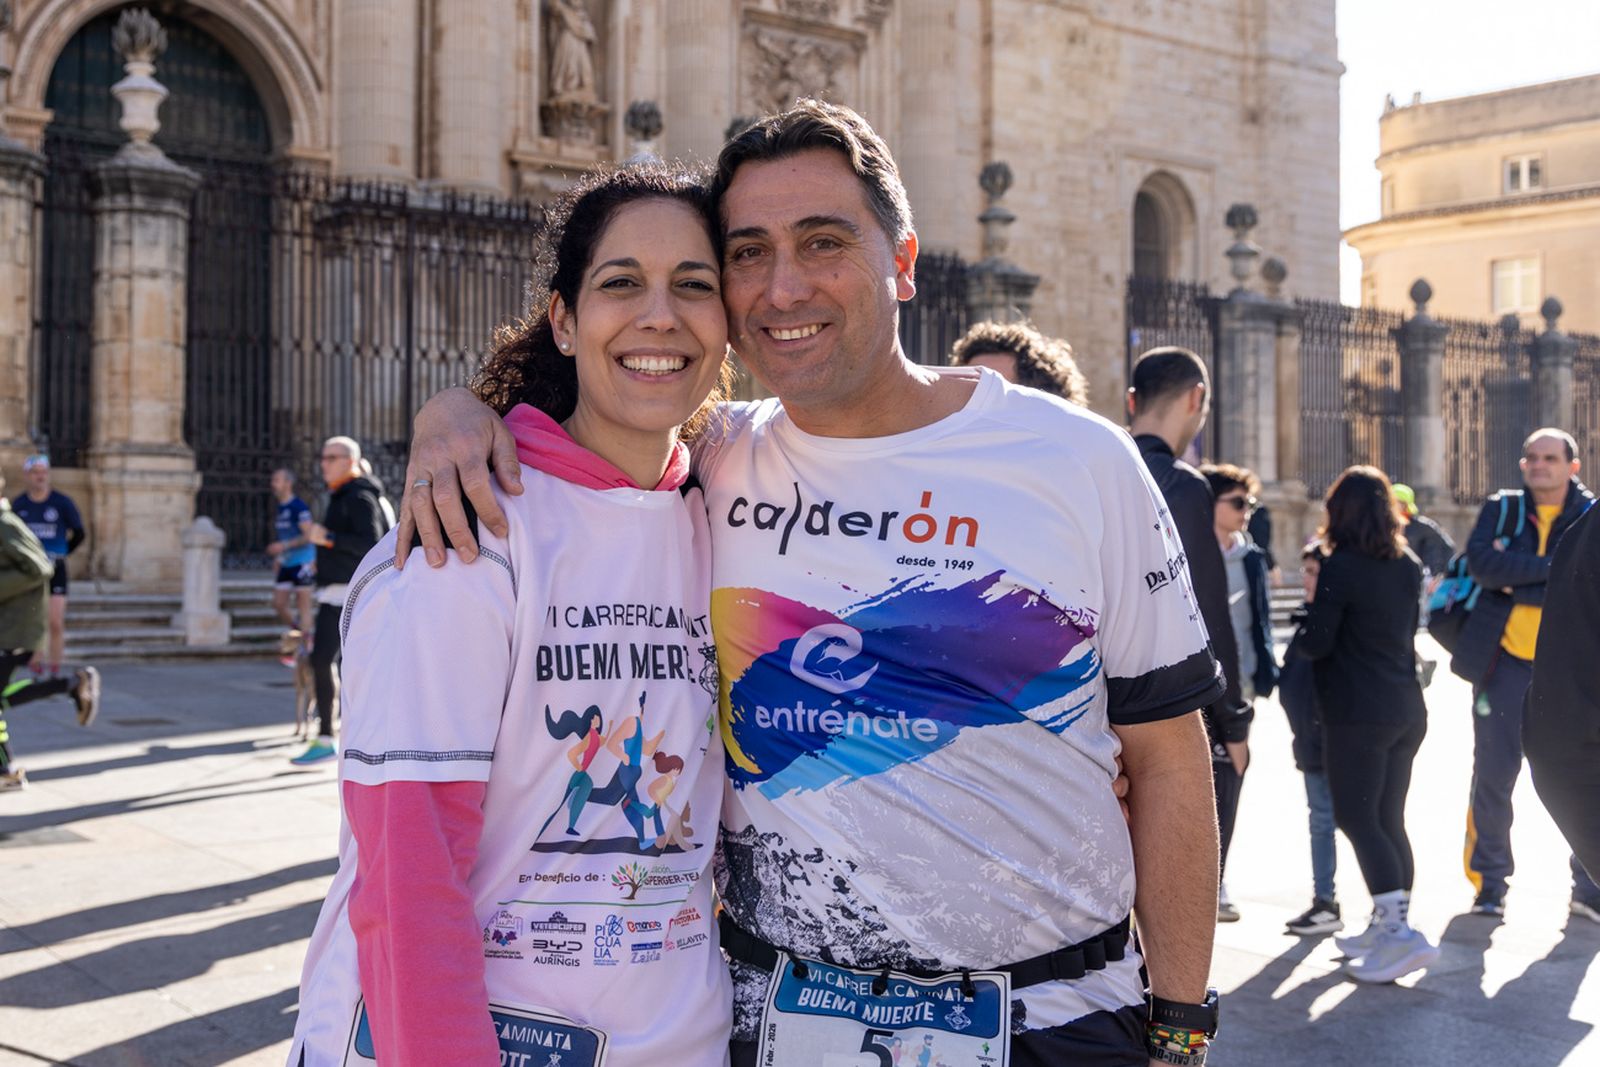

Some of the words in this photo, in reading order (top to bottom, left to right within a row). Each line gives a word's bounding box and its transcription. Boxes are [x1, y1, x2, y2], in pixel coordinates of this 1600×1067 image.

[727, 481, 979, 555] calderón
[896, 555, 936, 568] desde
[944, 559, 975, 571] 1949
[1144, 570, 1167, 591] Da
[536, 642, 622, 682] BUENA
[755, 699, 939, 743] entrénate
[518, 874, 532, 884] En
[534, 872, 582, 885] beneficio
[585, 872, 599, 882] de
[533, 939, 583, 951] BYD
[533, 956, 581, 967] AURINGIS
[807, 967, 822, 983] VI
[825, 971, 890, 997] CARREA
[797, 987, 856, 1015] BUENA
[861, 1001, 935, 1025] MUERTE
[860, 1028, 895, 1067] 5
